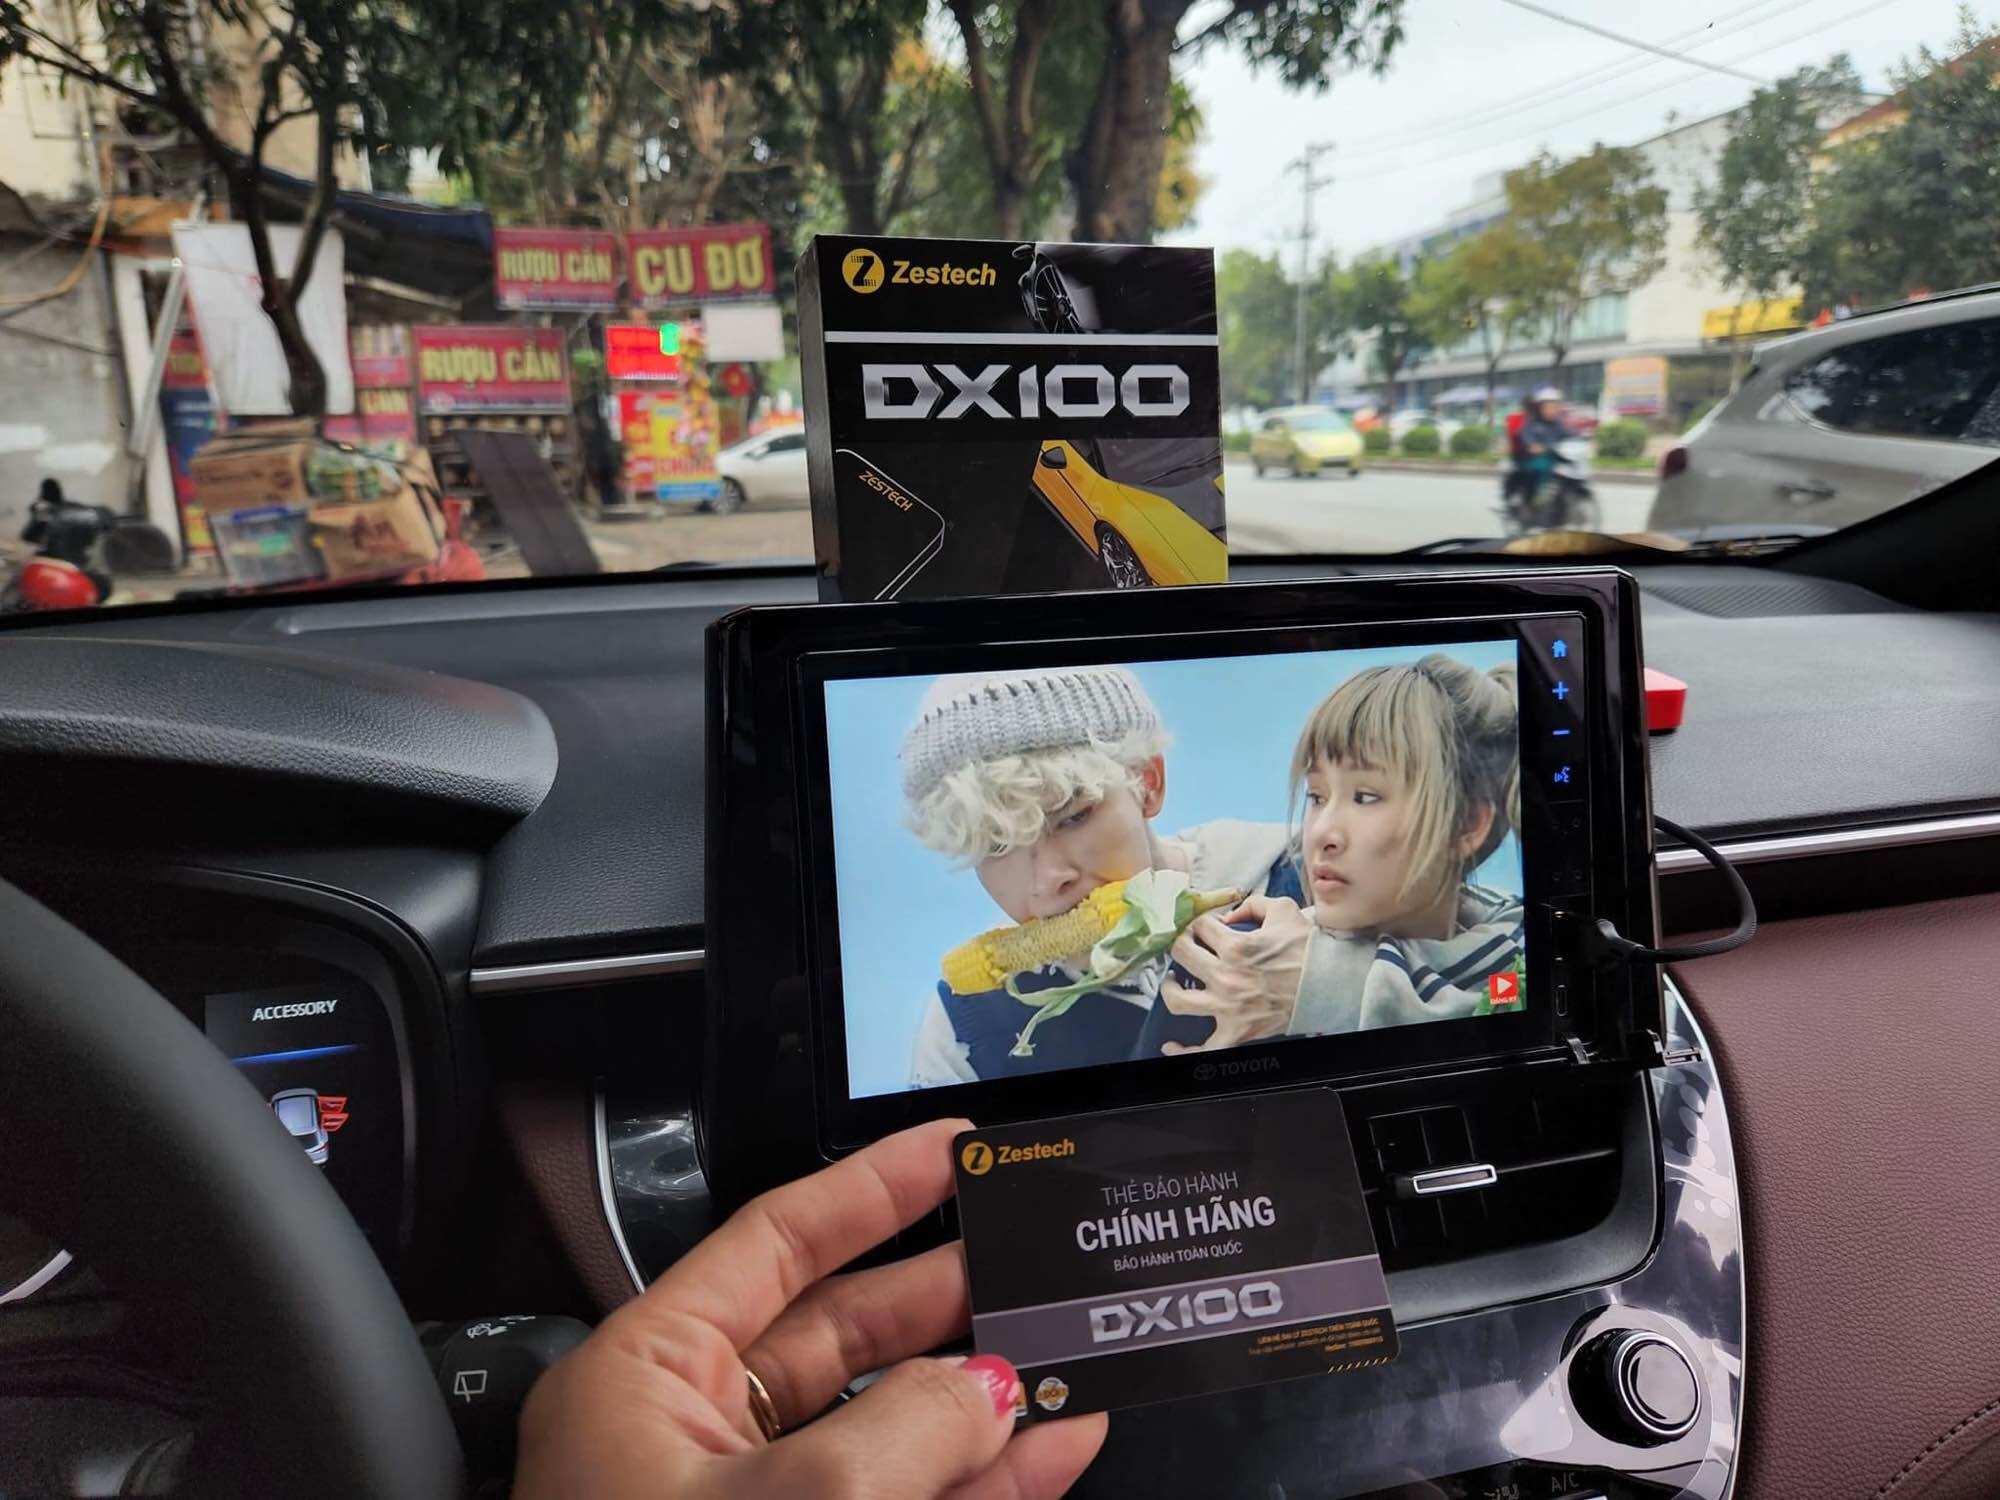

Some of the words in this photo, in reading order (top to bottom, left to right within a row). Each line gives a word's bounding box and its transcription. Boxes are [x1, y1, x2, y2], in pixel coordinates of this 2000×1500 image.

[891, 260, 997, 286] Zestech
[862, 364, 1190, 419] DX100
[859, 470, 913, 511] ZESTECH
[252, 999, 338, 1021] ACCESSORY
[1219, 1056, 1281, 1077] TOYOTA
[998, 1138, 1075, 1164] Zestech
[1143, 1175, 1181, 1201] BẢO
[1185, 1171, 1239, 1195] HÀNH
[1076, 1208, 1179, 1252] CHÍNH
[1186, 1195, 1276, 1236] HÃNG
[1140, 1251, 1175, 1267] HÀNH
[1176, 1245, 1208, 1262] TOÀN
[1210, 1239, 1243, 1257] QUỐC
[1089, 1280, 1284, 1343] DX100
[1551, 1472, 1579, 1493] A/C
